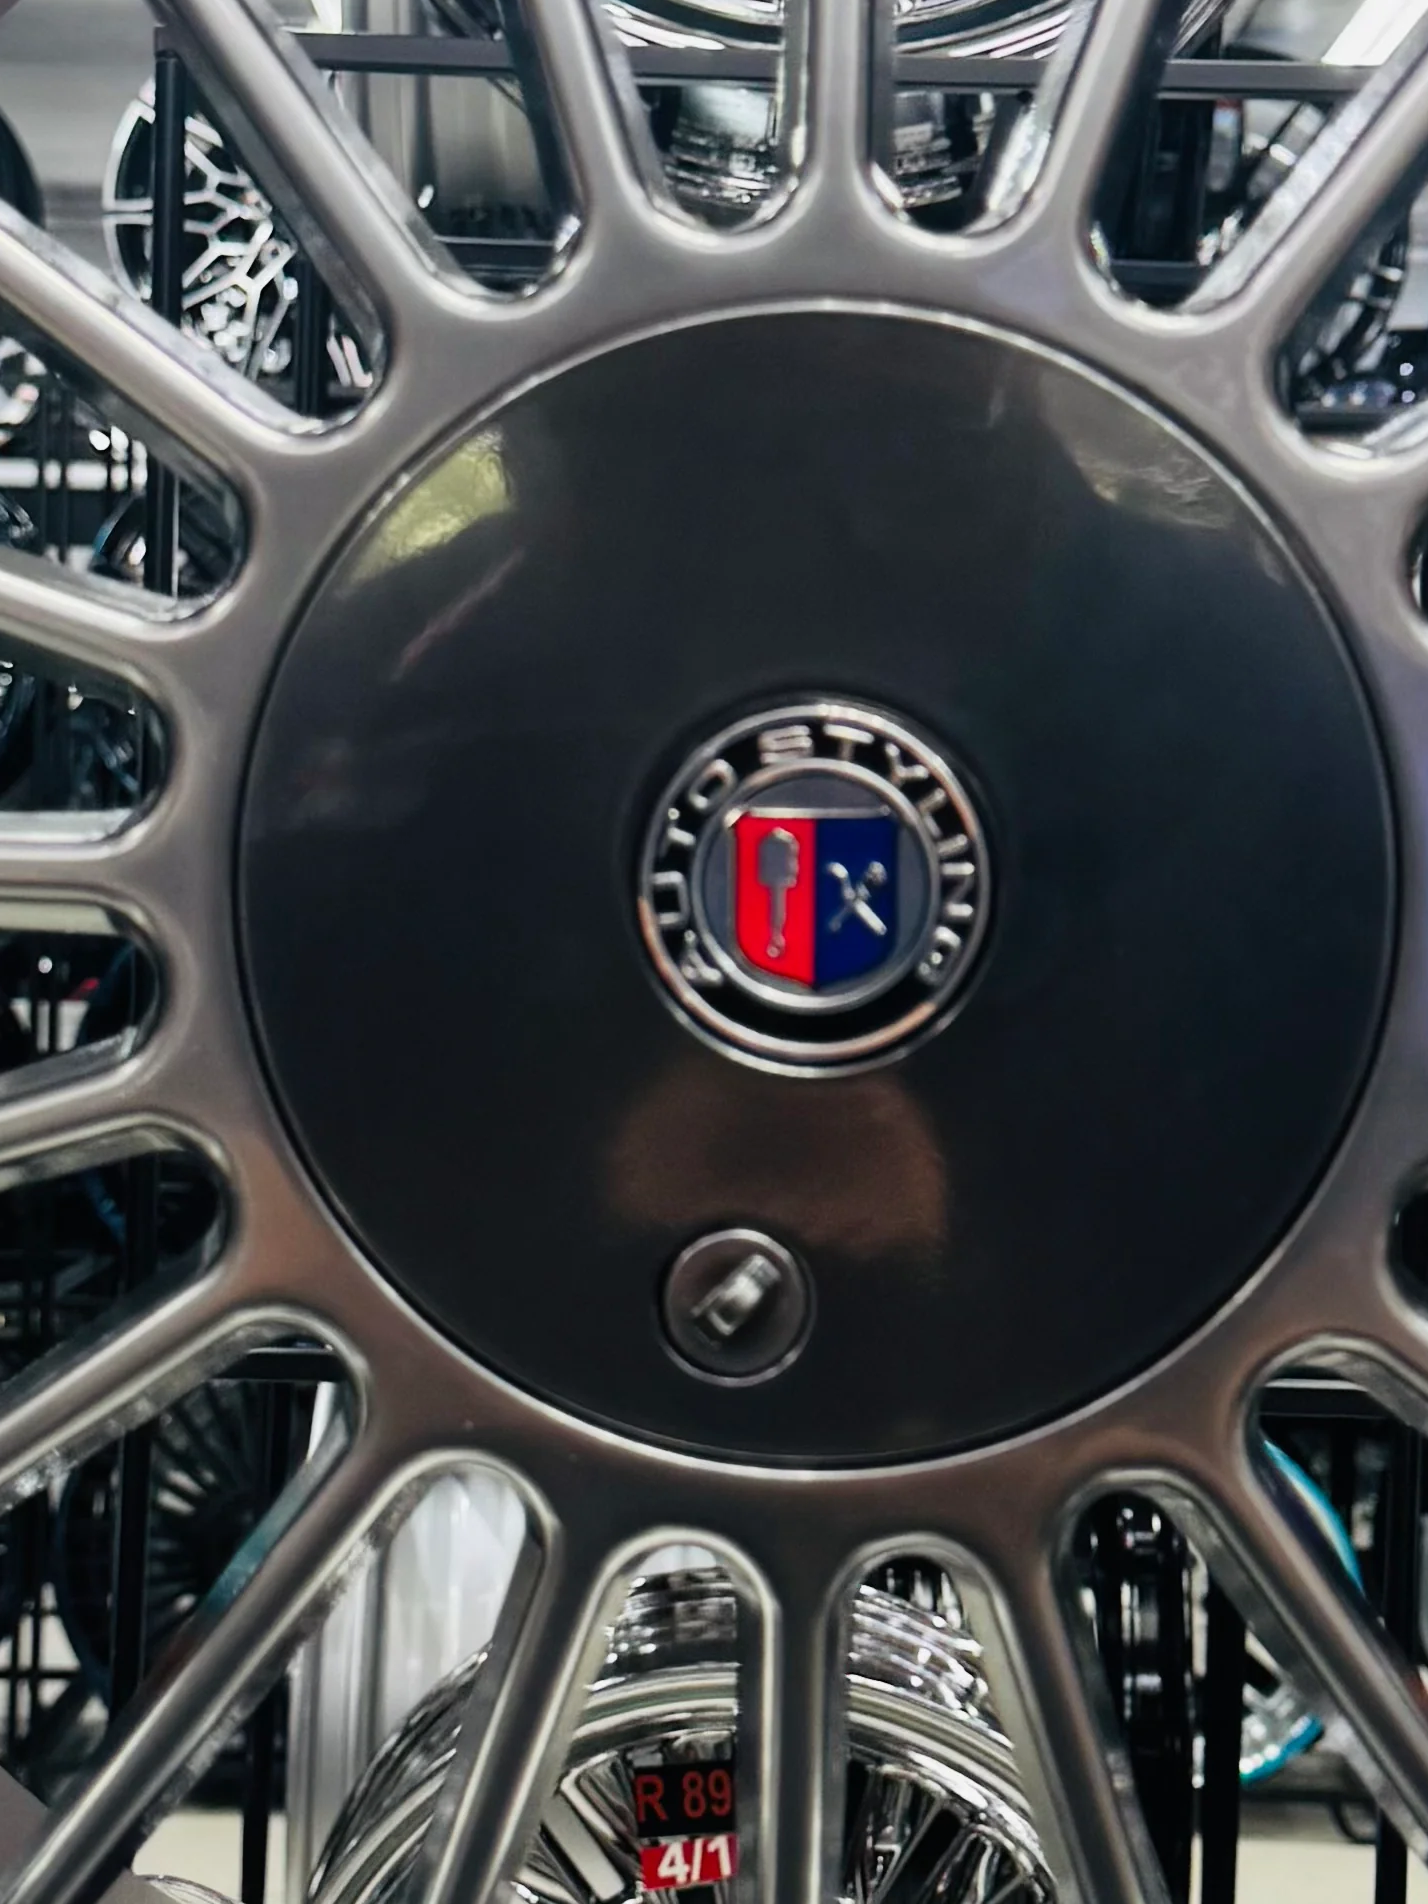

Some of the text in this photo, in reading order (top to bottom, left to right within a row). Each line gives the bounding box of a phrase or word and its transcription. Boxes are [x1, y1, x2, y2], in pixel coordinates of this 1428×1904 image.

[651, 724, 975, 986] AUTO STYLING
[635, 1769, 732, 1823] R 89
